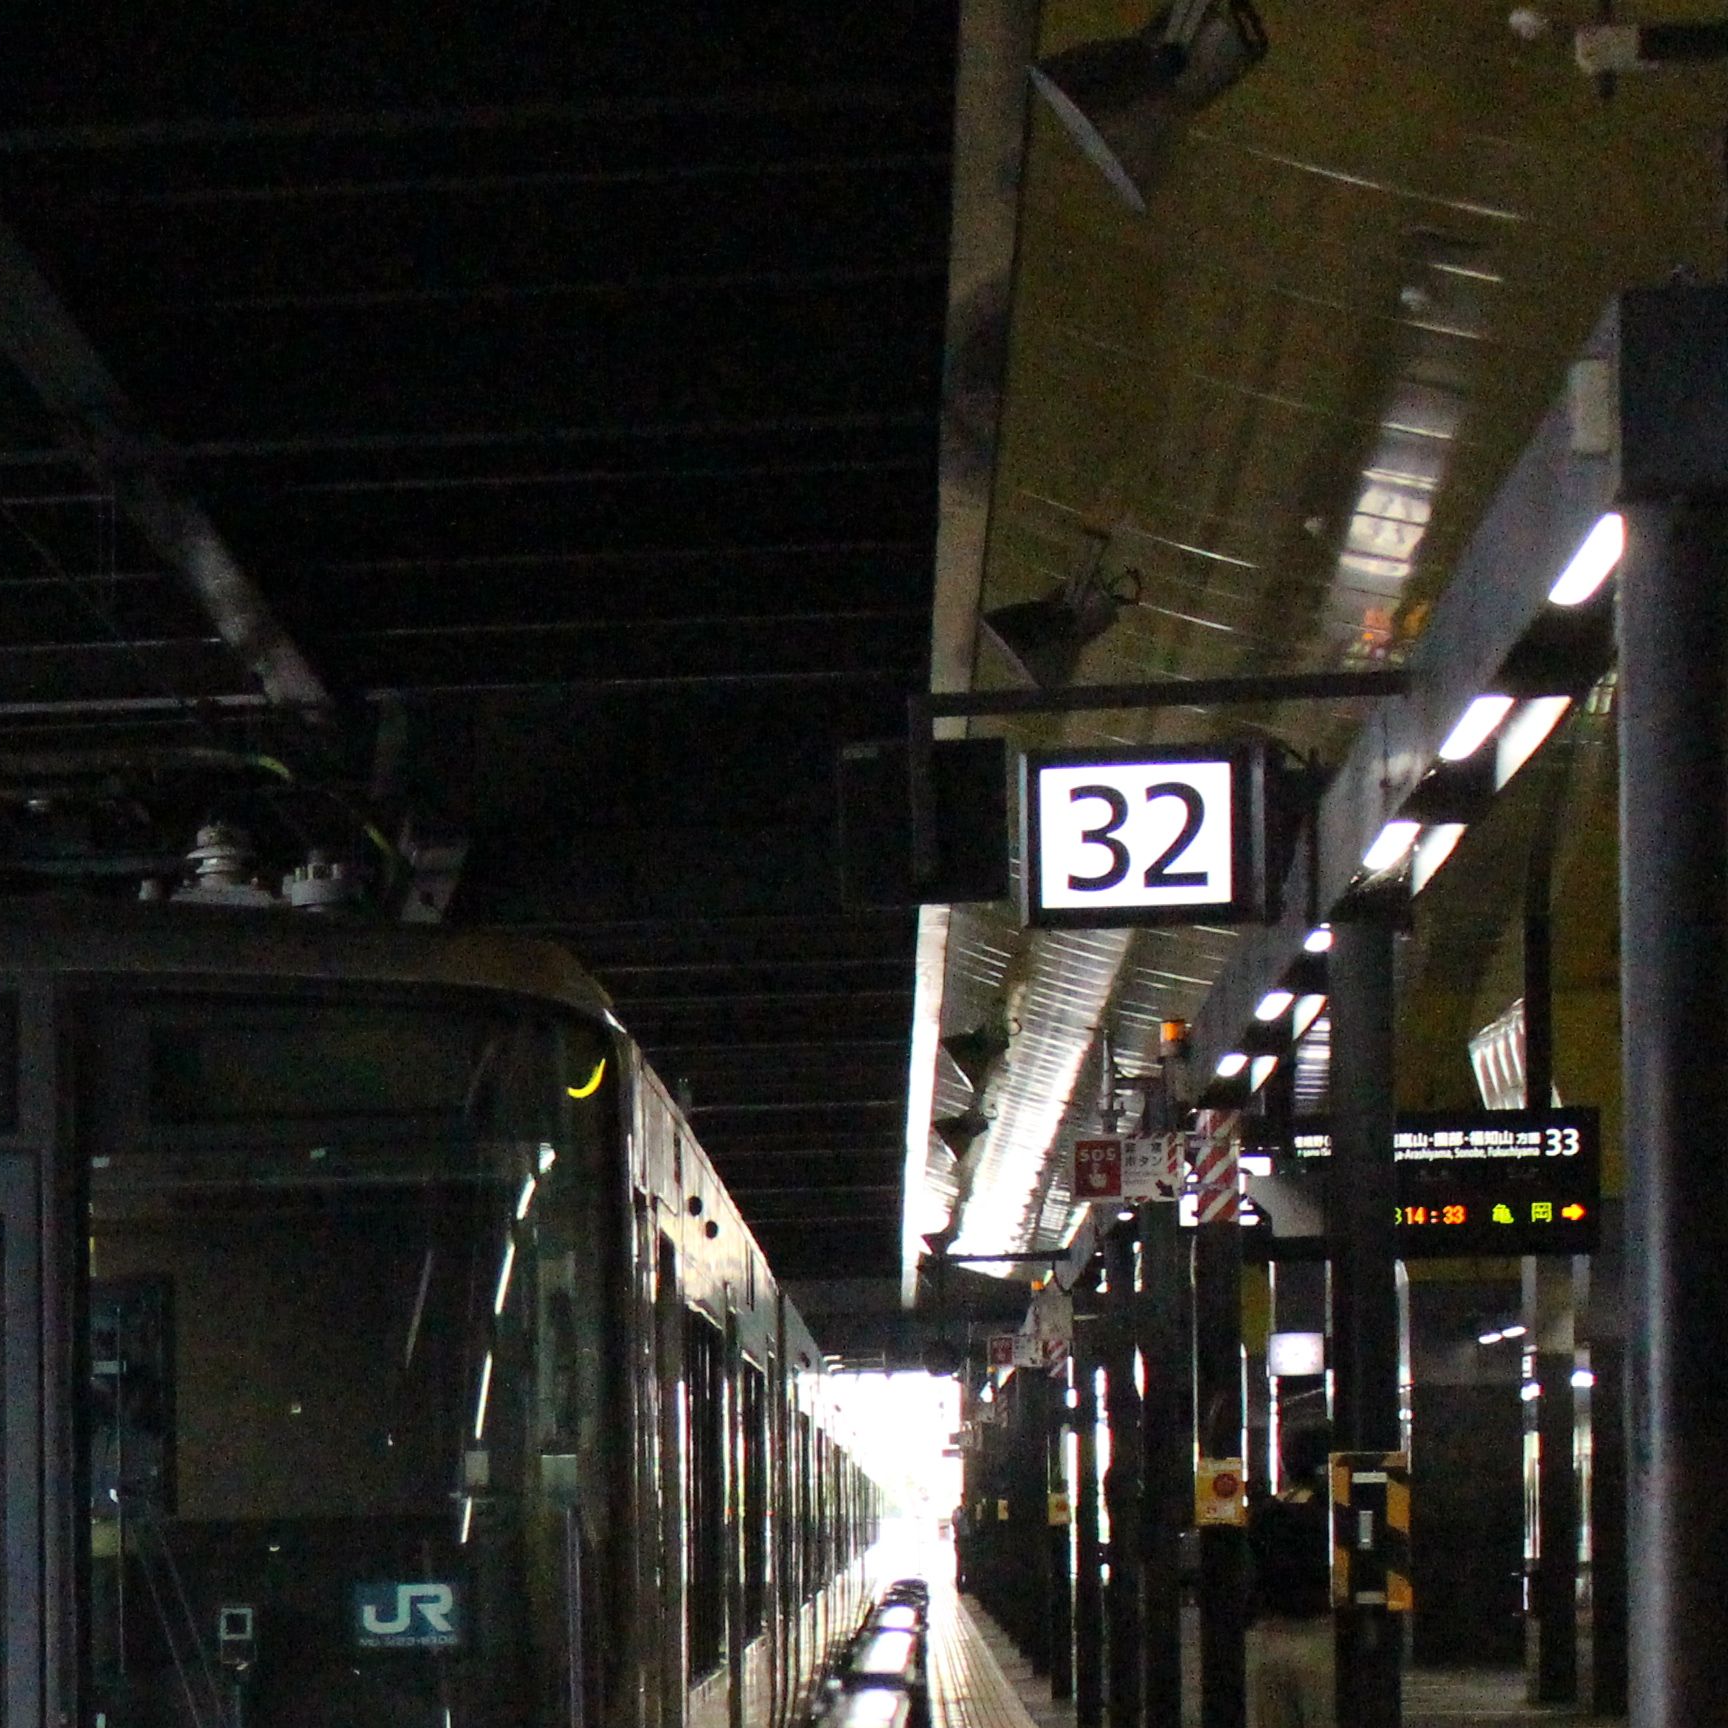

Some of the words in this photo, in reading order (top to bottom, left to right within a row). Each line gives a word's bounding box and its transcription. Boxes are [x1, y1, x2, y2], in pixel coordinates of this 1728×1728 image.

[1067, 781, 1209, 892] 32
[1079, 1148, 1117, 1163] SOS
[1544, 1127, 1580, 1157] 33
[363, 1583, 454, 1635] JR
